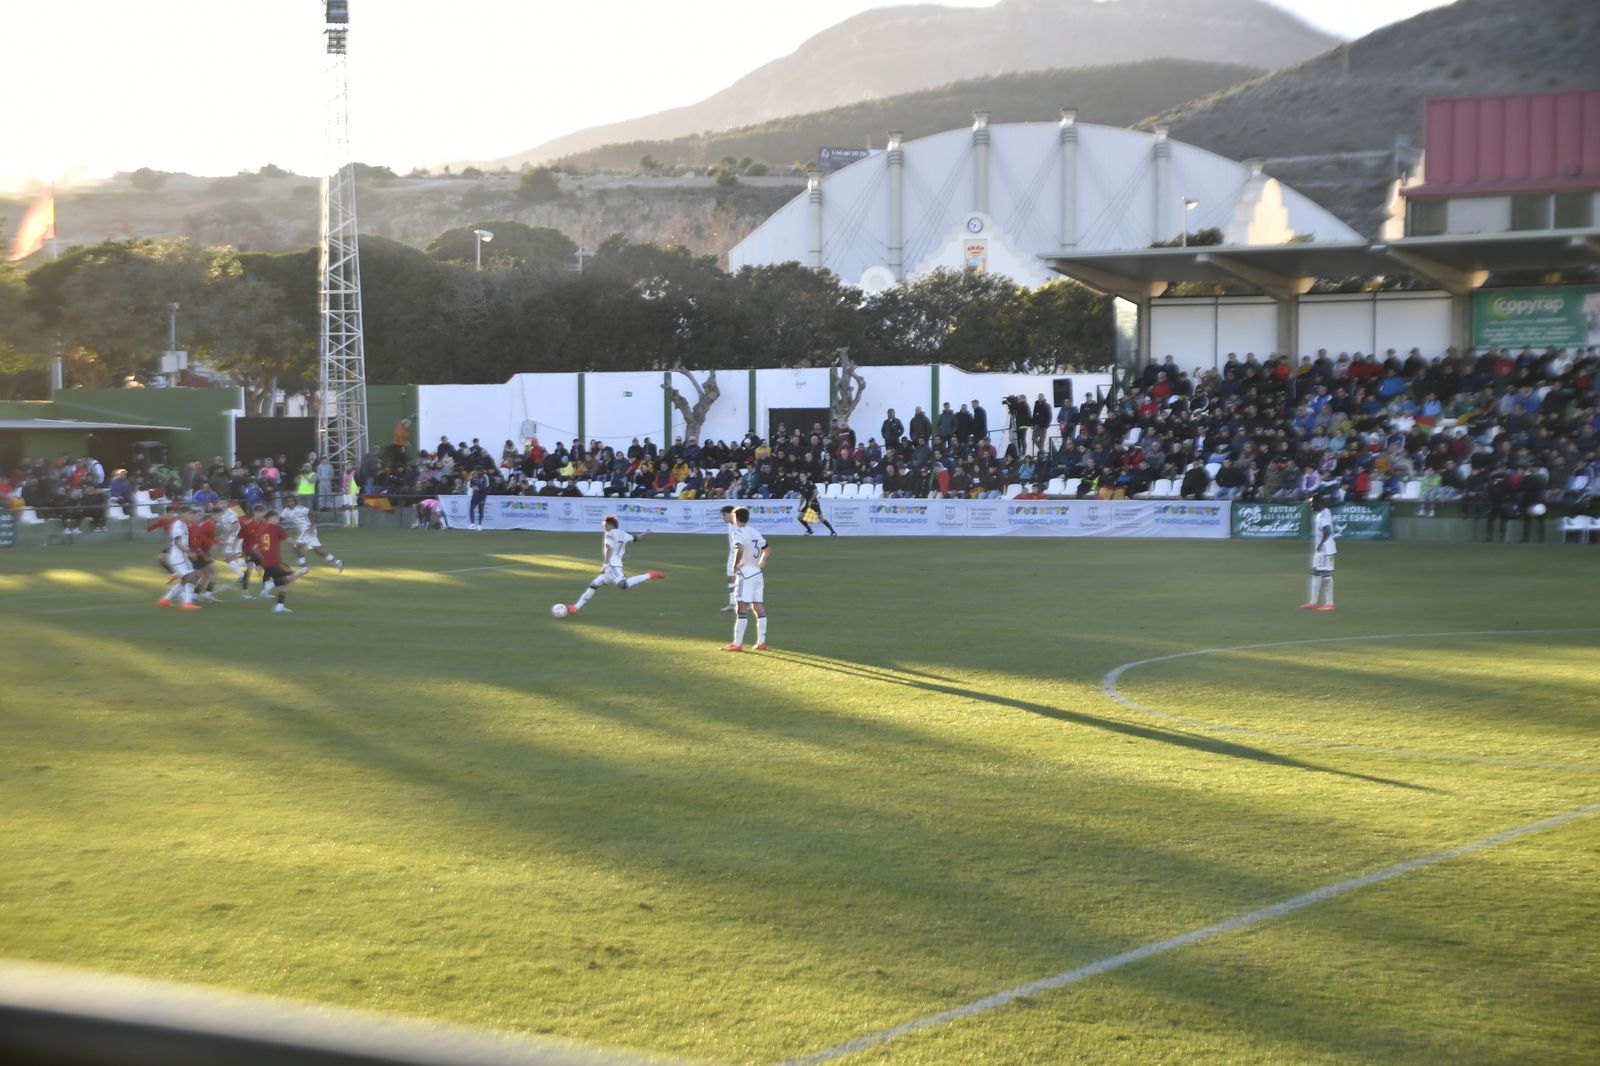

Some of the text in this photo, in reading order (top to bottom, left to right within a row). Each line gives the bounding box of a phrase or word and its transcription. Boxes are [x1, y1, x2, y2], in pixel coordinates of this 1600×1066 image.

[1499, 298, 1565, 315] copyrap
[263, 533, 271, 551] 9
[617, 540, 624, 556] 7
[751, 539, 761, 559] 3
